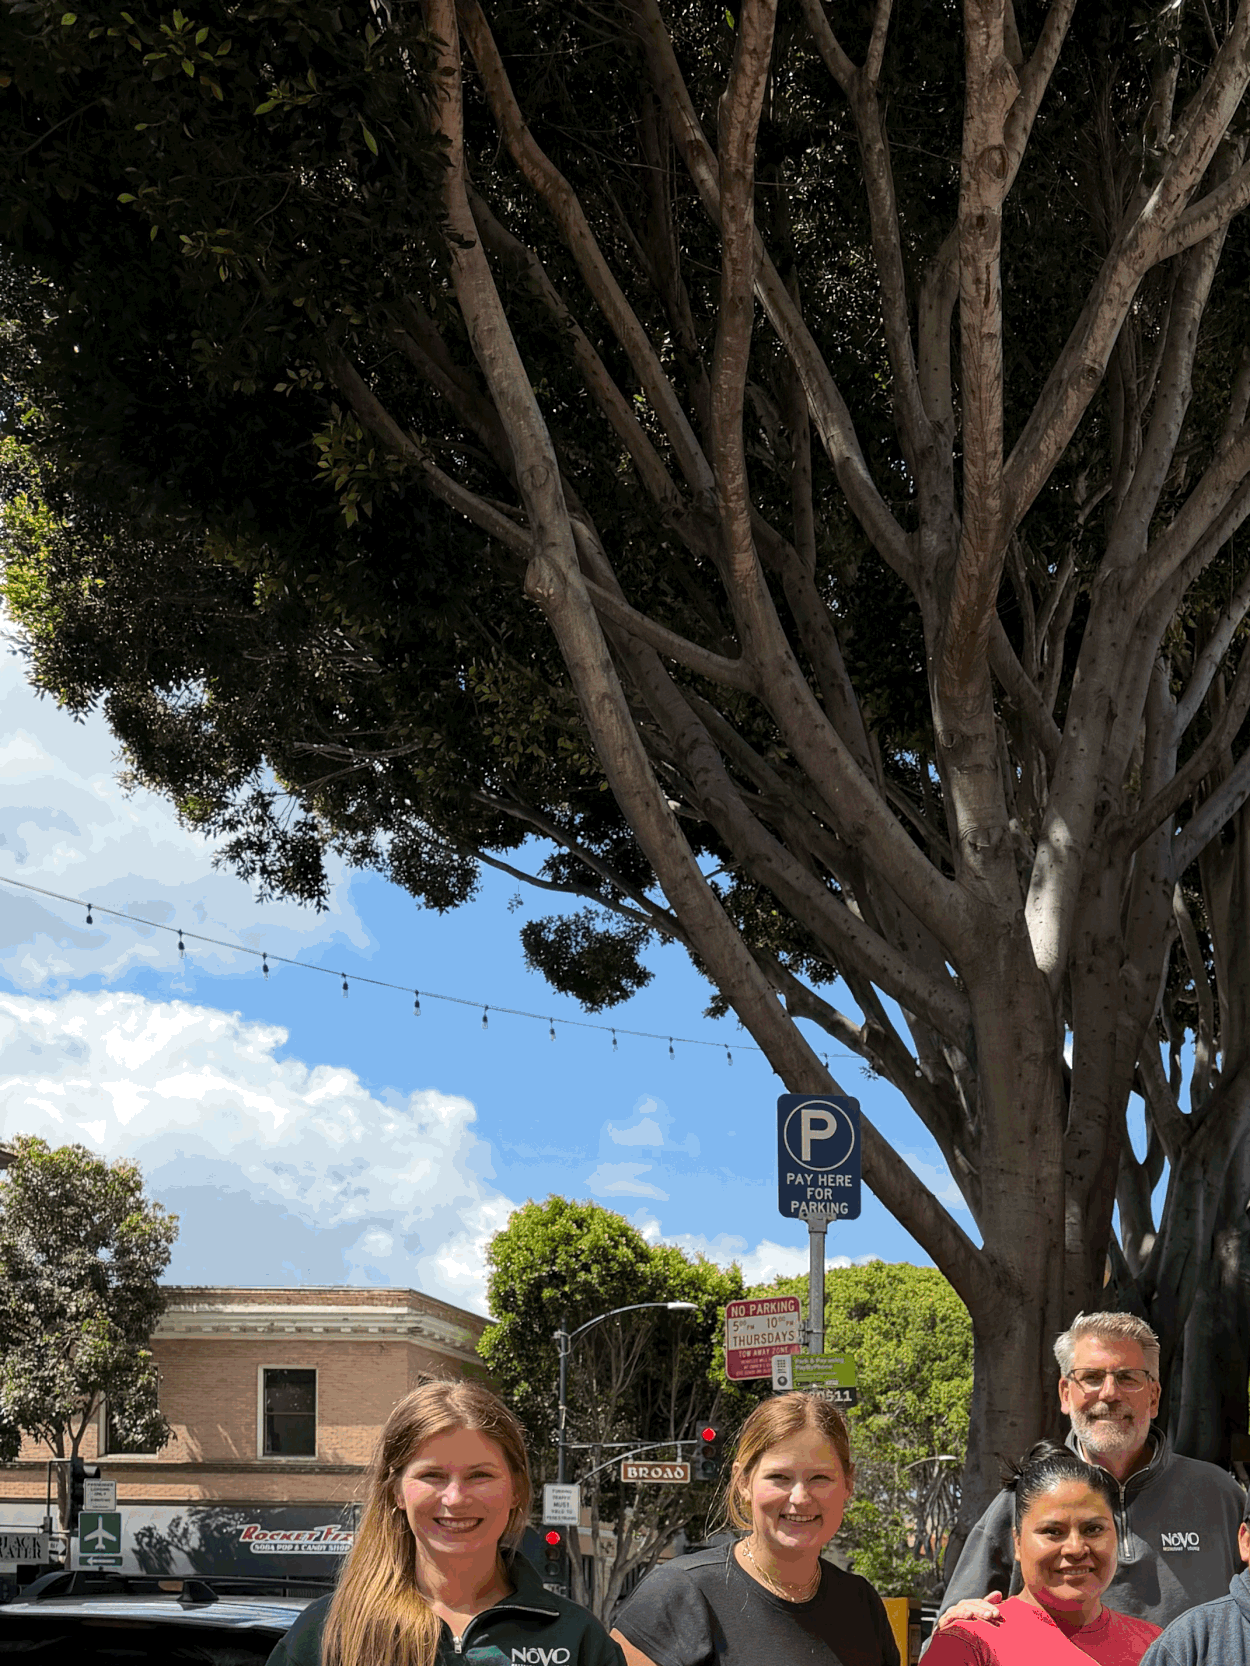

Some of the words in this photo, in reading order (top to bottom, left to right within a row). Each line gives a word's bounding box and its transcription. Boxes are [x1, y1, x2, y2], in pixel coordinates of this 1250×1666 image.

[786, 1173, 814, 1186] PAY
[818, 1174, 852, 1187] HERE
[807, 1187, 833, 1200] FOR
[791, 1200, 849, 1215] PARKING
[731, 1305, 746, 1318] NO
[749, 1300, 795, 1315] PARKING
[733, 1331, 795, 1347] THURSDAYS
[739, 1350, 751, 1359] TOW
[753, 1348, 770, 1358] AWAY
[772, 1346, 789, 1355] ZONE
[627, 1467, 685, 1479] BROAD
[0, 1547, 41, 1560] ATER
[254, 1542, 274, 1552] SODA
[276, 1543, 294, 1552] POP
[301, 1542, 327, 1552] CANDY
[328, 1543, 351, 1552] SHOP
